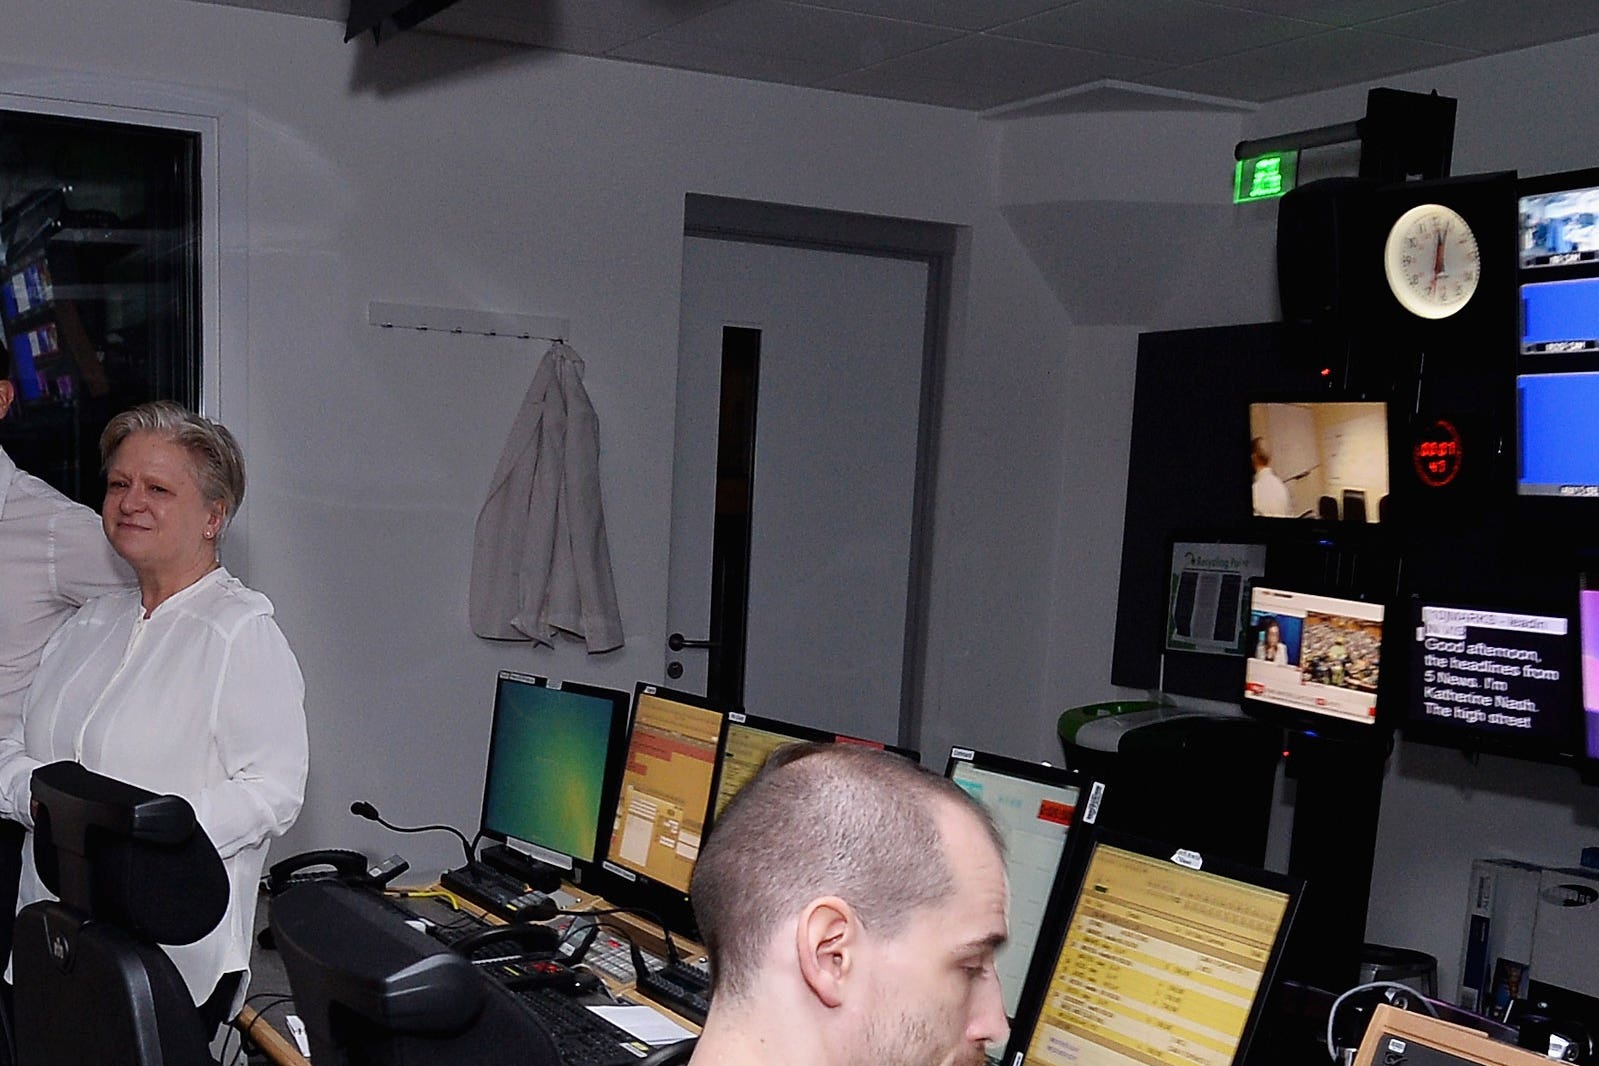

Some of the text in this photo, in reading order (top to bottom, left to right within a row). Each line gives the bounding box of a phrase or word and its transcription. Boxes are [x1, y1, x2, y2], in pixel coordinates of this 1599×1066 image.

[1424, 638, 1543, 663] Good afternoon,
[1423, 670, 1436, 683] 5
[1424, 654, 1560, 681] the headlines from
[1424, 686, 1493, 707] Katherine
[1424, 702, 1533, 729] The high street
